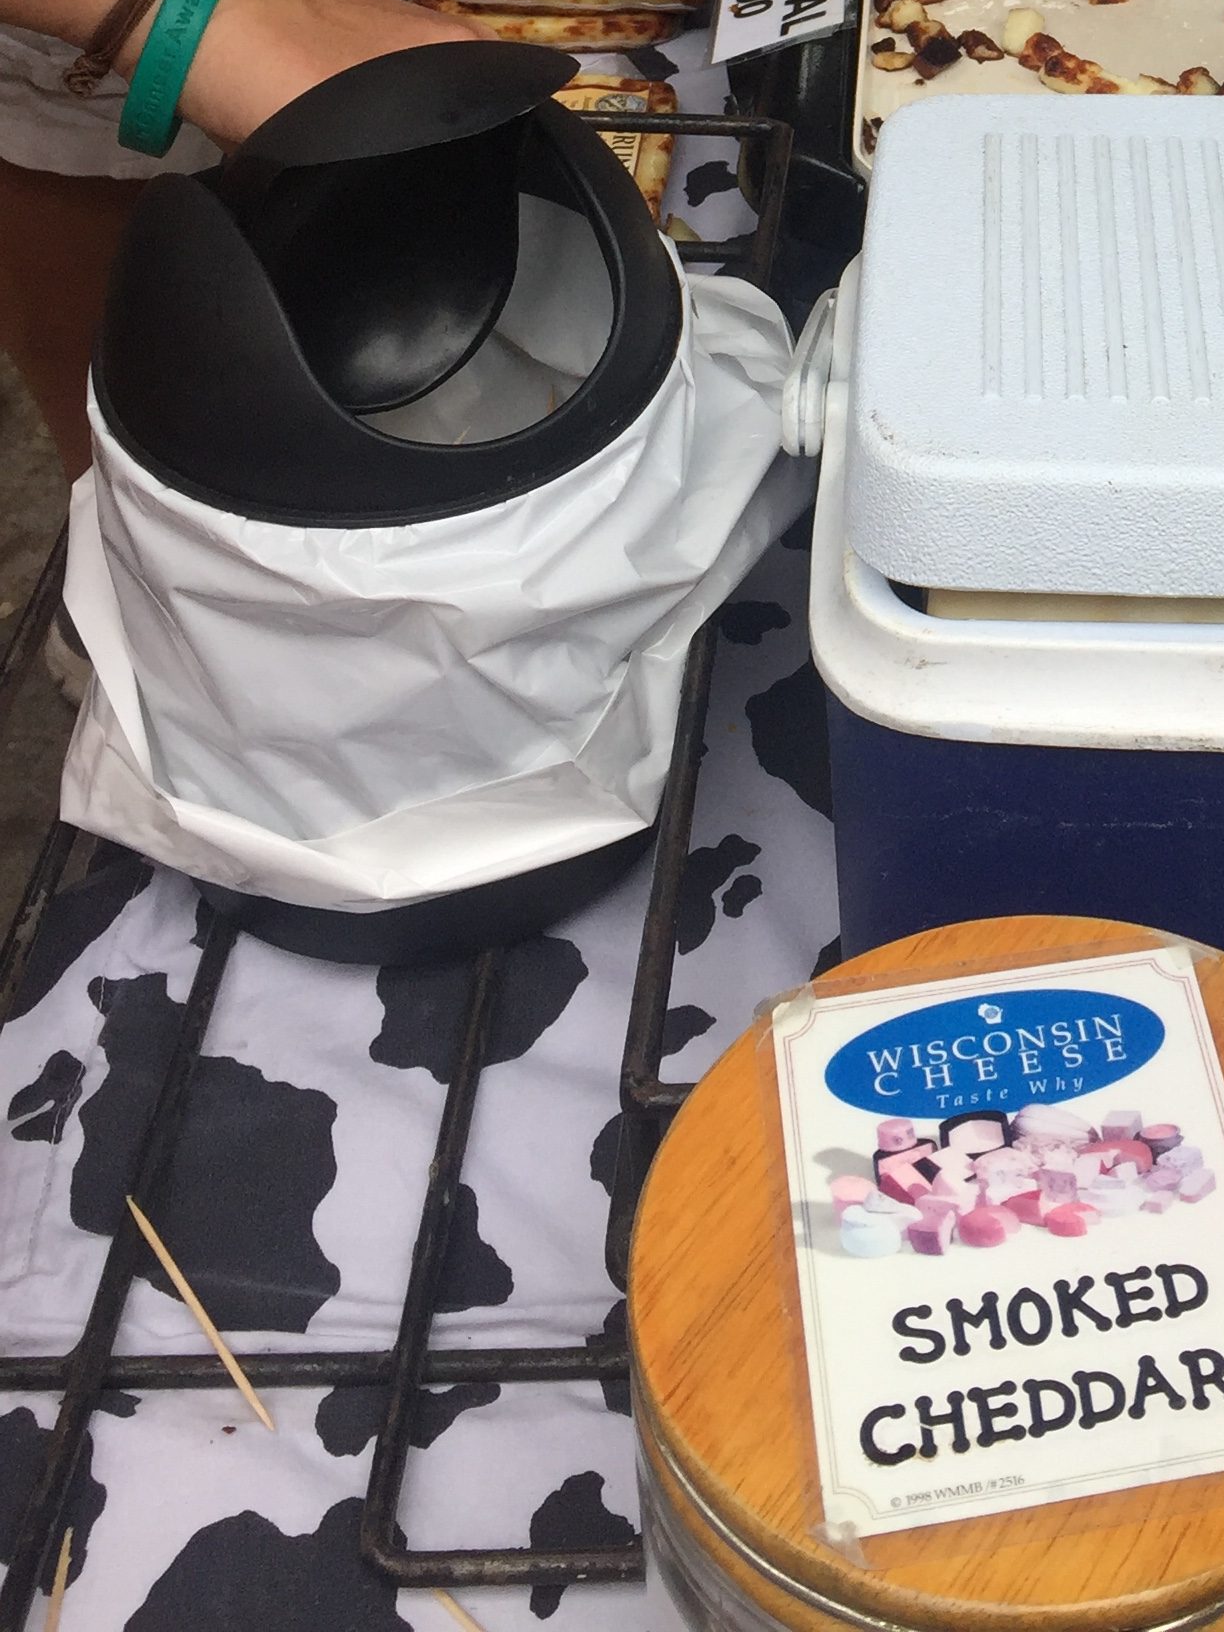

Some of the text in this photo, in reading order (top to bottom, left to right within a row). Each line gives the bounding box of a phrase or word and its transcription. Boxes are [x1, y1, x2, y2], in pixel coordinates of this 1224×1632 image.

[867, 1014, 1123, 1073] WISCONSIN
[873, 1038, 1127, 1096] CHEESE
[936, 1076, 1085, 1108] Taste Why
[892, 1263, 1209, 1364] SMOKED
[906, 1491, 933, 1505] 1998
[934, 1481, 983, 1500] WMMB
